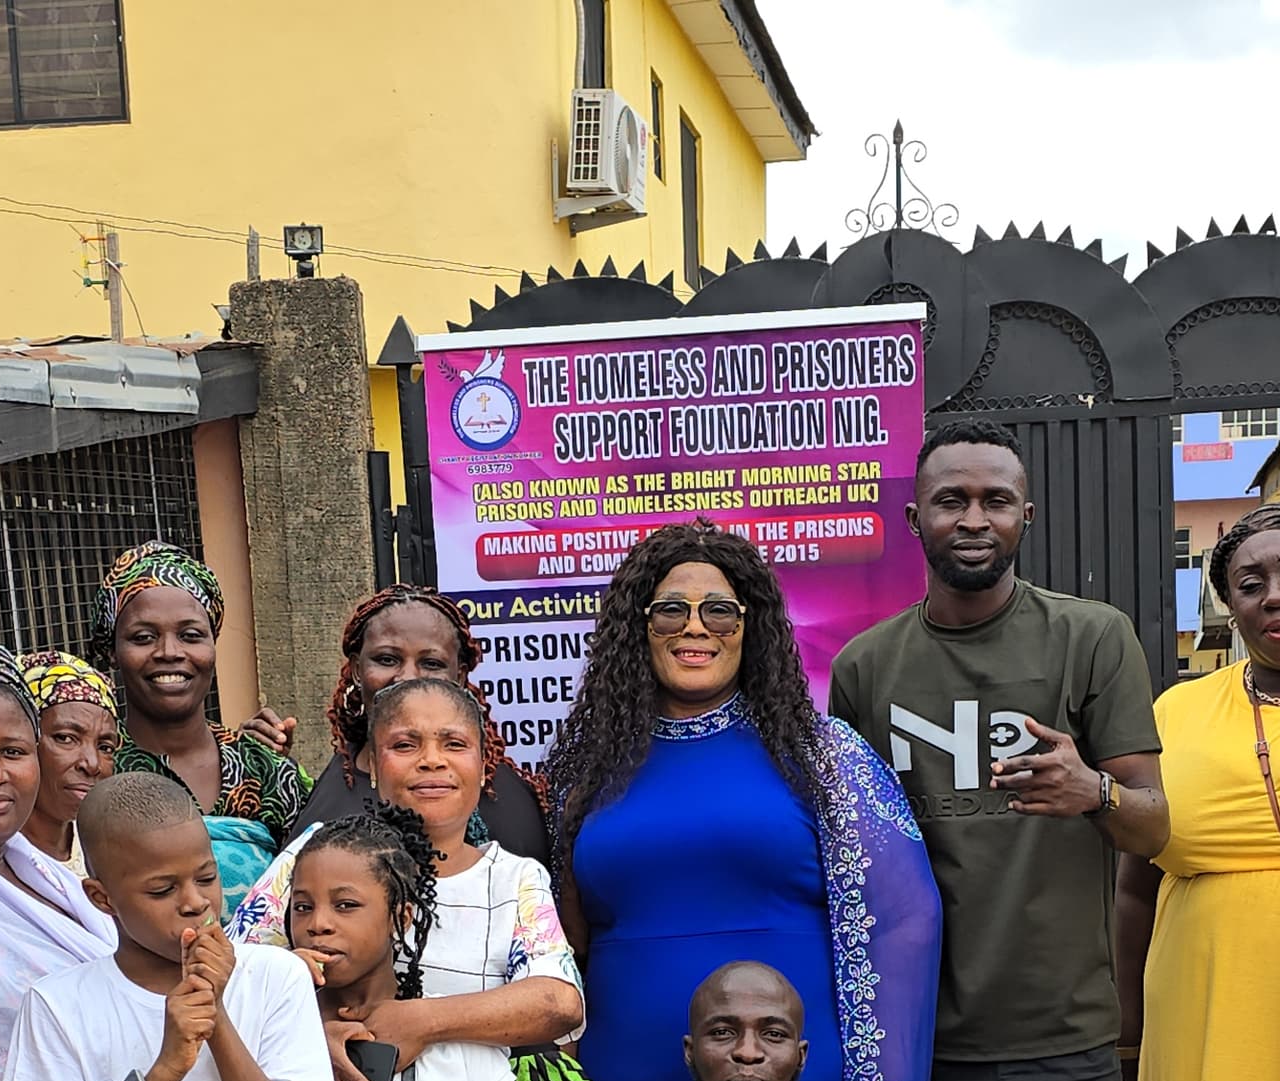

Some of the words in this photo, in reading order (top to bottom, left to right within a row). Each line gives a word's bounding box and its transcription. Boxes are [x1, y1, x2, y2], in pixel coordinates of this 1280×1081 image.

[523, 357, 569, 407] THE
[575, 347, 706, 405] HOMELESS
[712, 344, 766, 396] AND
[772, 334, 915, 393] PRISONERS
[553, 408, 663, 463] SUPPORT
[669, 399, 826, 456] FOUNDATION
[832, 395, 888, 448] NIG.
[467, 463, 513, 475] 6983779
[529, 477, 600, 498] KNOWN
[605, 475, 629, 494] AS
[633, 473, 666, 492] THE
[671, 469, 736, 490] BRIGHT
[741, 464, 832, 487] MORNING
[837, 461, 881, 481] STAR
[476, 501, 554, 522] PRISONS
[559, 499, 597, 518] AND
[602, 490, 744, 516] HOMELESSNESS
[749, 485, 842, 508] OUTREACH
[847, 483, 880, 503] UK)
[484, 535, 556, 556] MAKING
[562, 530, 639, 552] POSITIVE
[755, 521, 788, 542] THE
[794, 517, 874, 539] PRISONS
[537, 555, 575, 575] AND
[774, 543, 819, 563] 2015
[456, 598, 503, 619] Our
[509, 590, 601, 618] Activiti
[479, 675, 574, 705] POLICE
